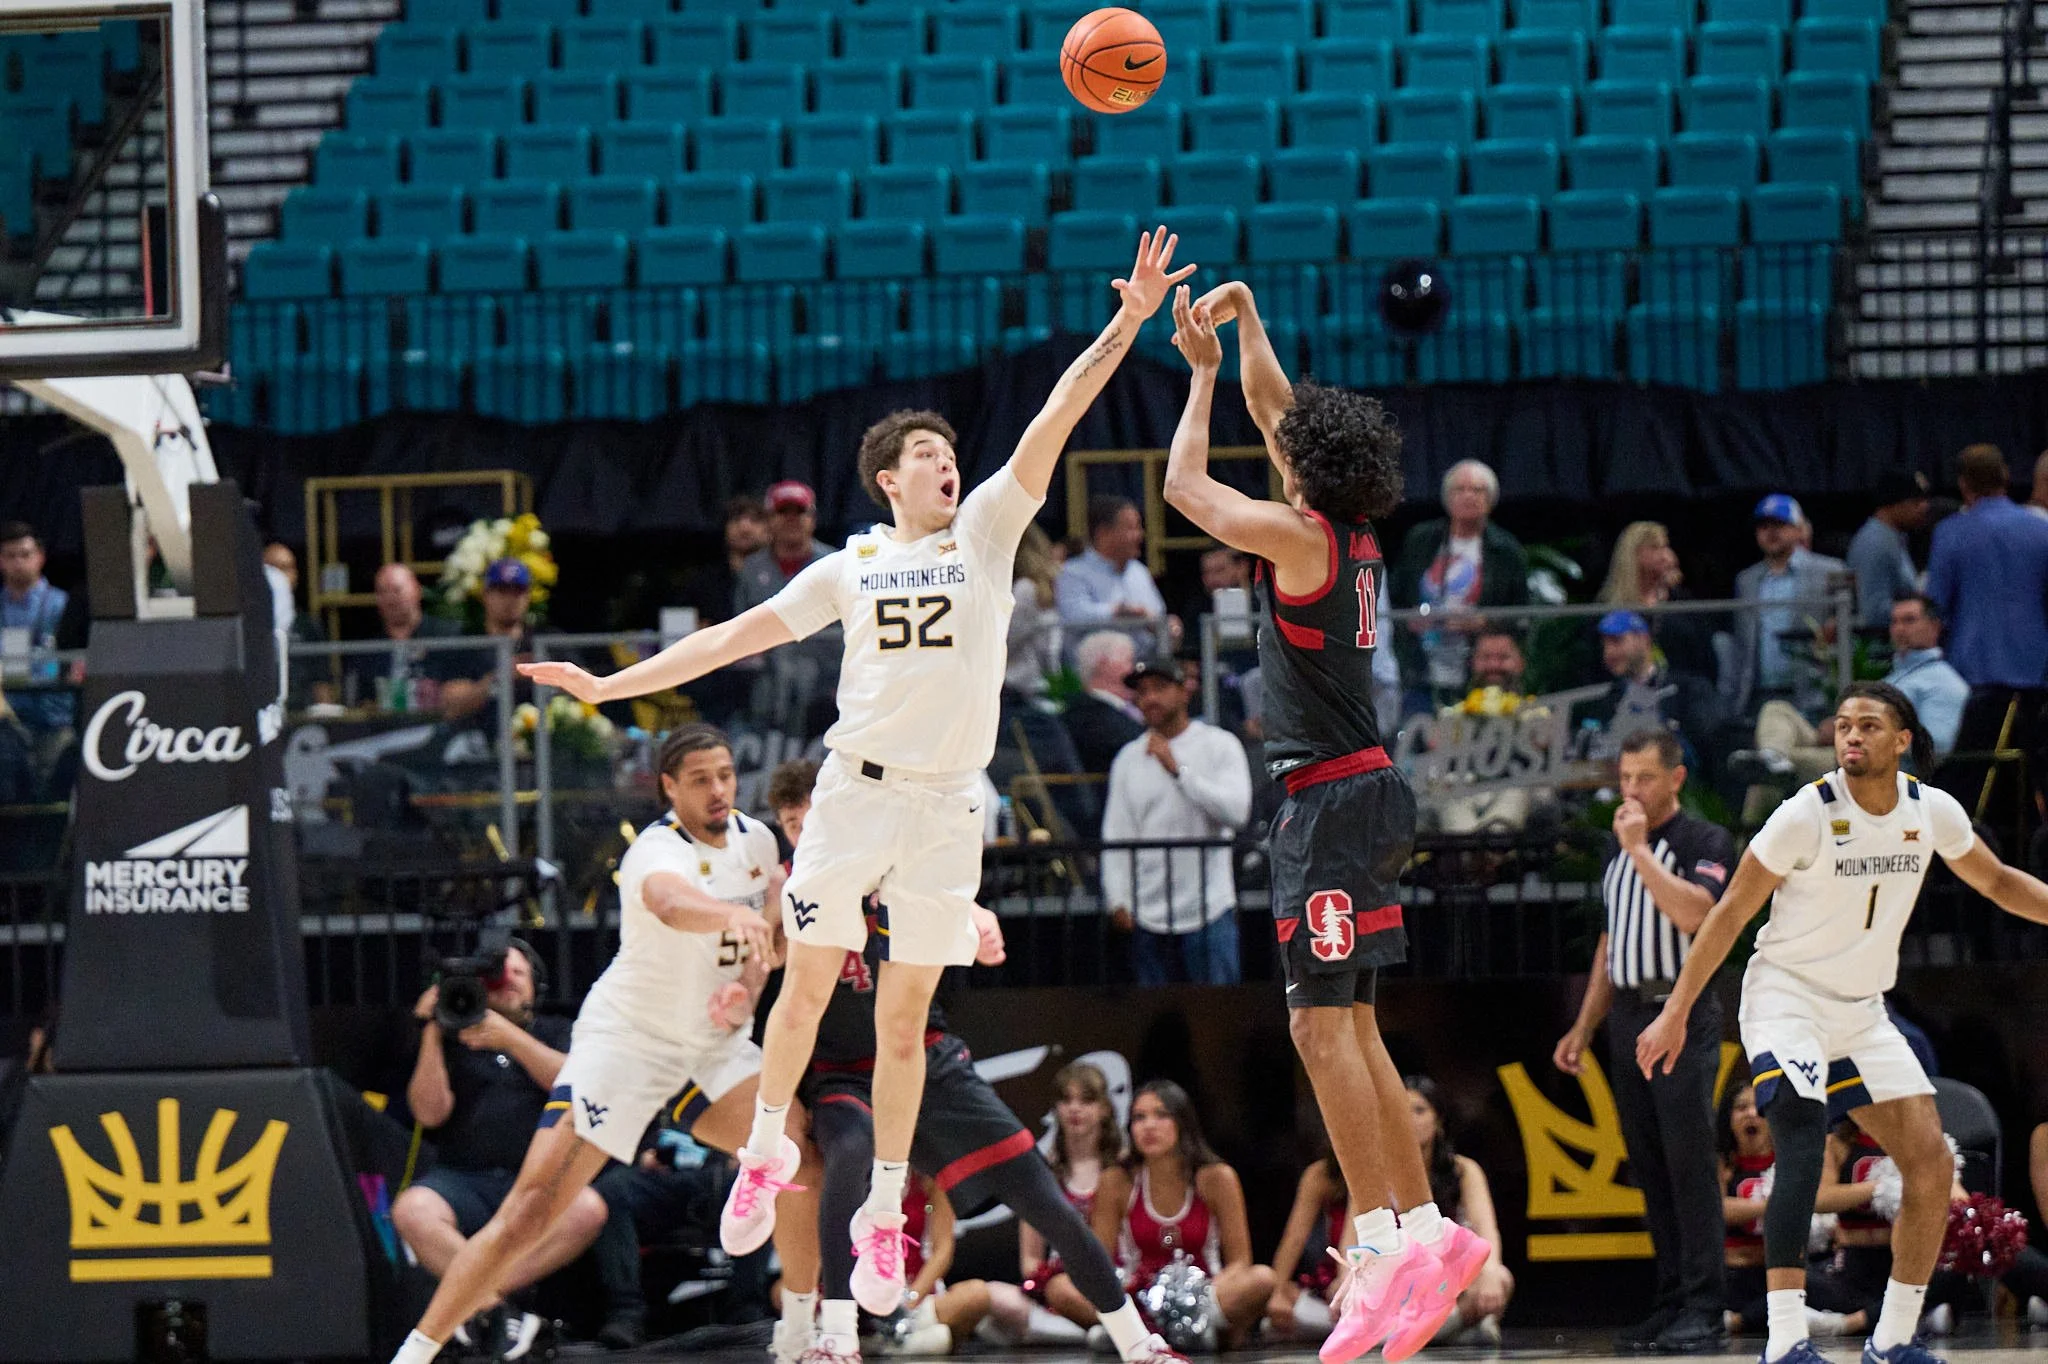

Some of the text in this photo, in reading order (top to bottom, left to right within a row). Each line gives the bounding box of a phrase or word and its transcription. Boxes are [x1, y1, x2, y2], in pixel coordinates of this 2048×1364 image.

[860, 564, 965, 592] MOUNTAINEERS
[876, 593, 953, 650] 52
[1356, 567, 1377, 648] 11
[83, 691, 251, 781] Circa
[85, 859, 249, 889] MERCURY
[1835, 854, 1919, 876] MOUNTAINEERS
[85, 886, 250, 914] INSURANCE
[1864, 884, 1879, 929] 1
